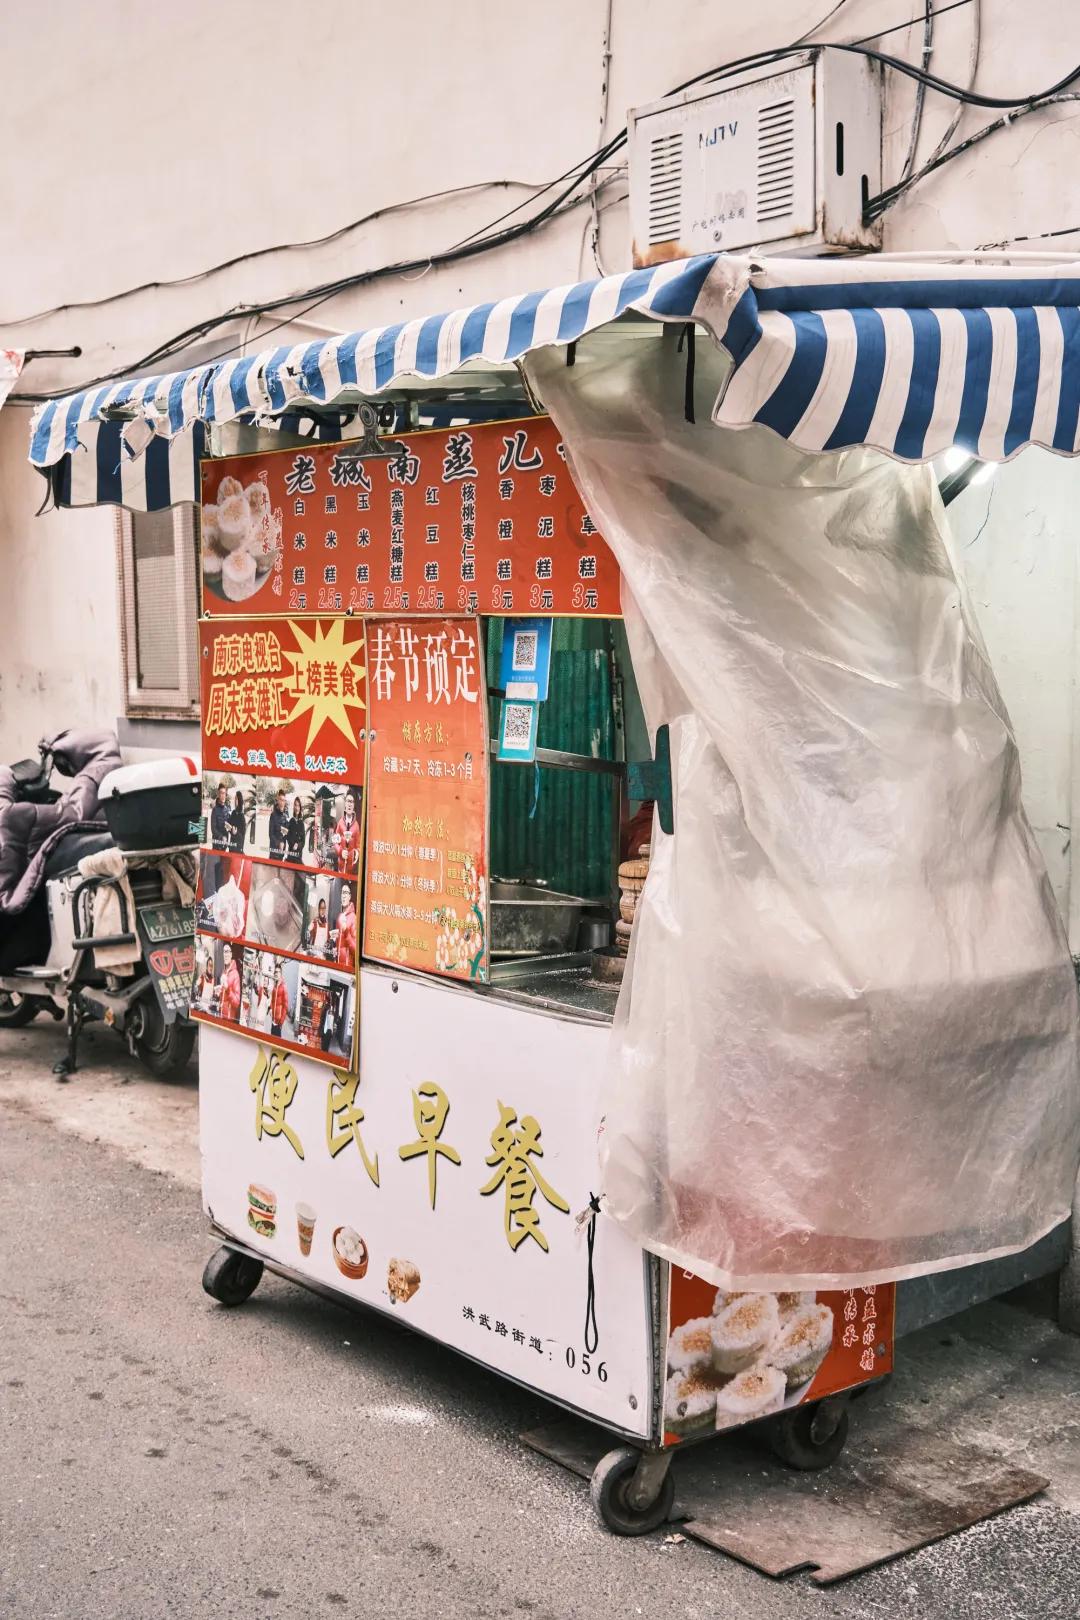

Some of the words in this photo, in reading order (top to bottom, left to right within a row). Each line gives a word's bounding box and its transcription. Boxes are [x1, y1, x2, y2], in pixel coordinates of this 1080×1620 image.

[699, 121, 738, 149] NJTV
[284, 430, 566, 495] 老城南蒸儿
[293, 498, 306, 584] 白米糕
[324, 496, 337, 583] 黑米糕
[356, 492, 370, 582] 玉米糕
[390, 488, 404, 583] 燕麦红糖糕
[425, 487, 439, 581] 红豆糕
[461, 483, 475, 581] 核桃枣仁糕
[498, 479, 514, 580] 香橙糕
[536, 476, 555, 579] 枣泥糕
[579, 514, 598, 578] 草糕
[289, 587, 307, 609] 2元
[318, 587, 342, 609] 2.5元
[350, 586, 374, 609] 2.5元
[383, 586, 410, 609] 2.5元
[417, 585, 444, 609] 2.5元
[458, 585, 478, 609] 3元
[492, 585, 513, 609] 3元
[530, 584, 554, 609] 3元
[572, 583, 598, 609] 3元
[212, 631, 282, 677] 南京电视台
[291, 660, 356, 698] 上榜美食
[370, 628, 478, 705] 春节预定
[205, 677, 290, 737] 周末英雄汇
[249, 1044, 570, 1253] 便民早餐
[843, 1286, 859, 1348] 传承
